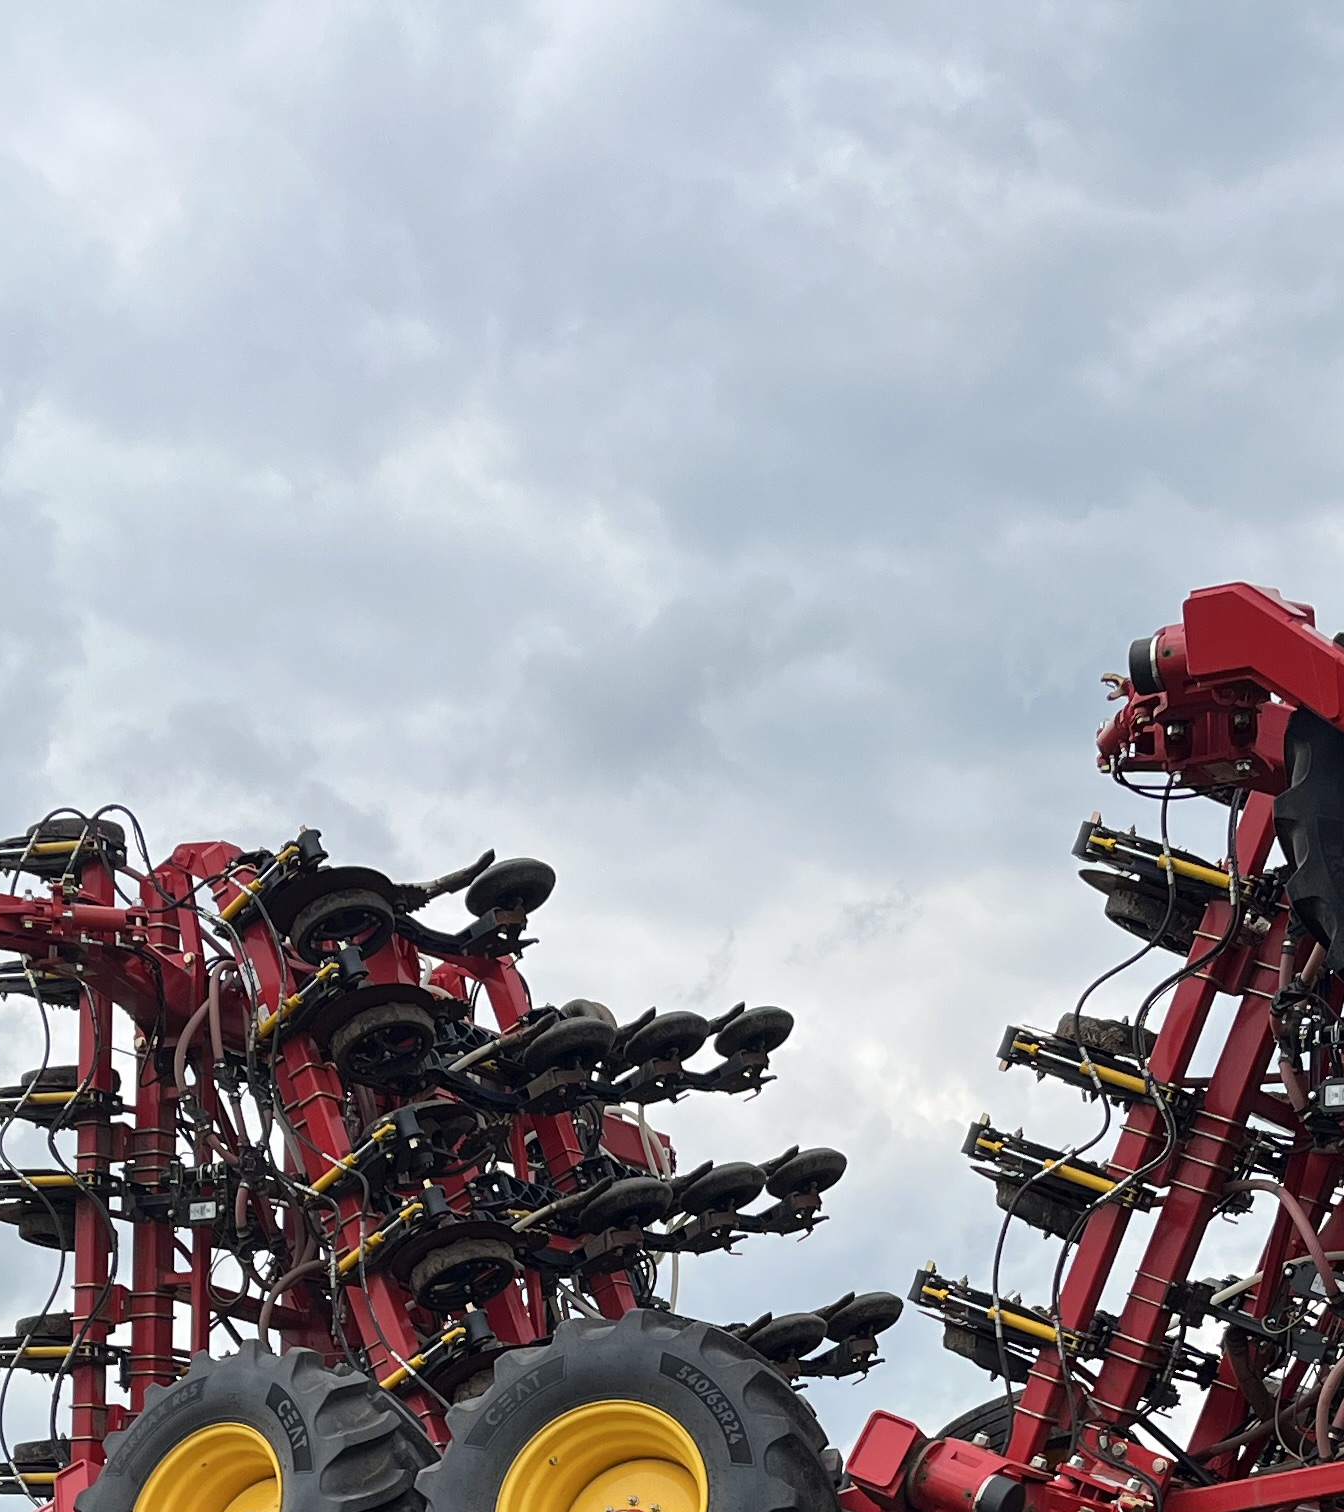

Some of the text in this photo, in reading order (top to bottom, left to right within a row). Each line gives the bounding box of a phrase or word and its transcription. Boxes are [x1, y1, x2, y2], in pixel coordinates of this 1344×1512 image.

[276, 1398, 308, 1450] CEAT
[485, 1370, 543, 1426] CEAT
[675, 1364, 745, 1446] 540/65R24
